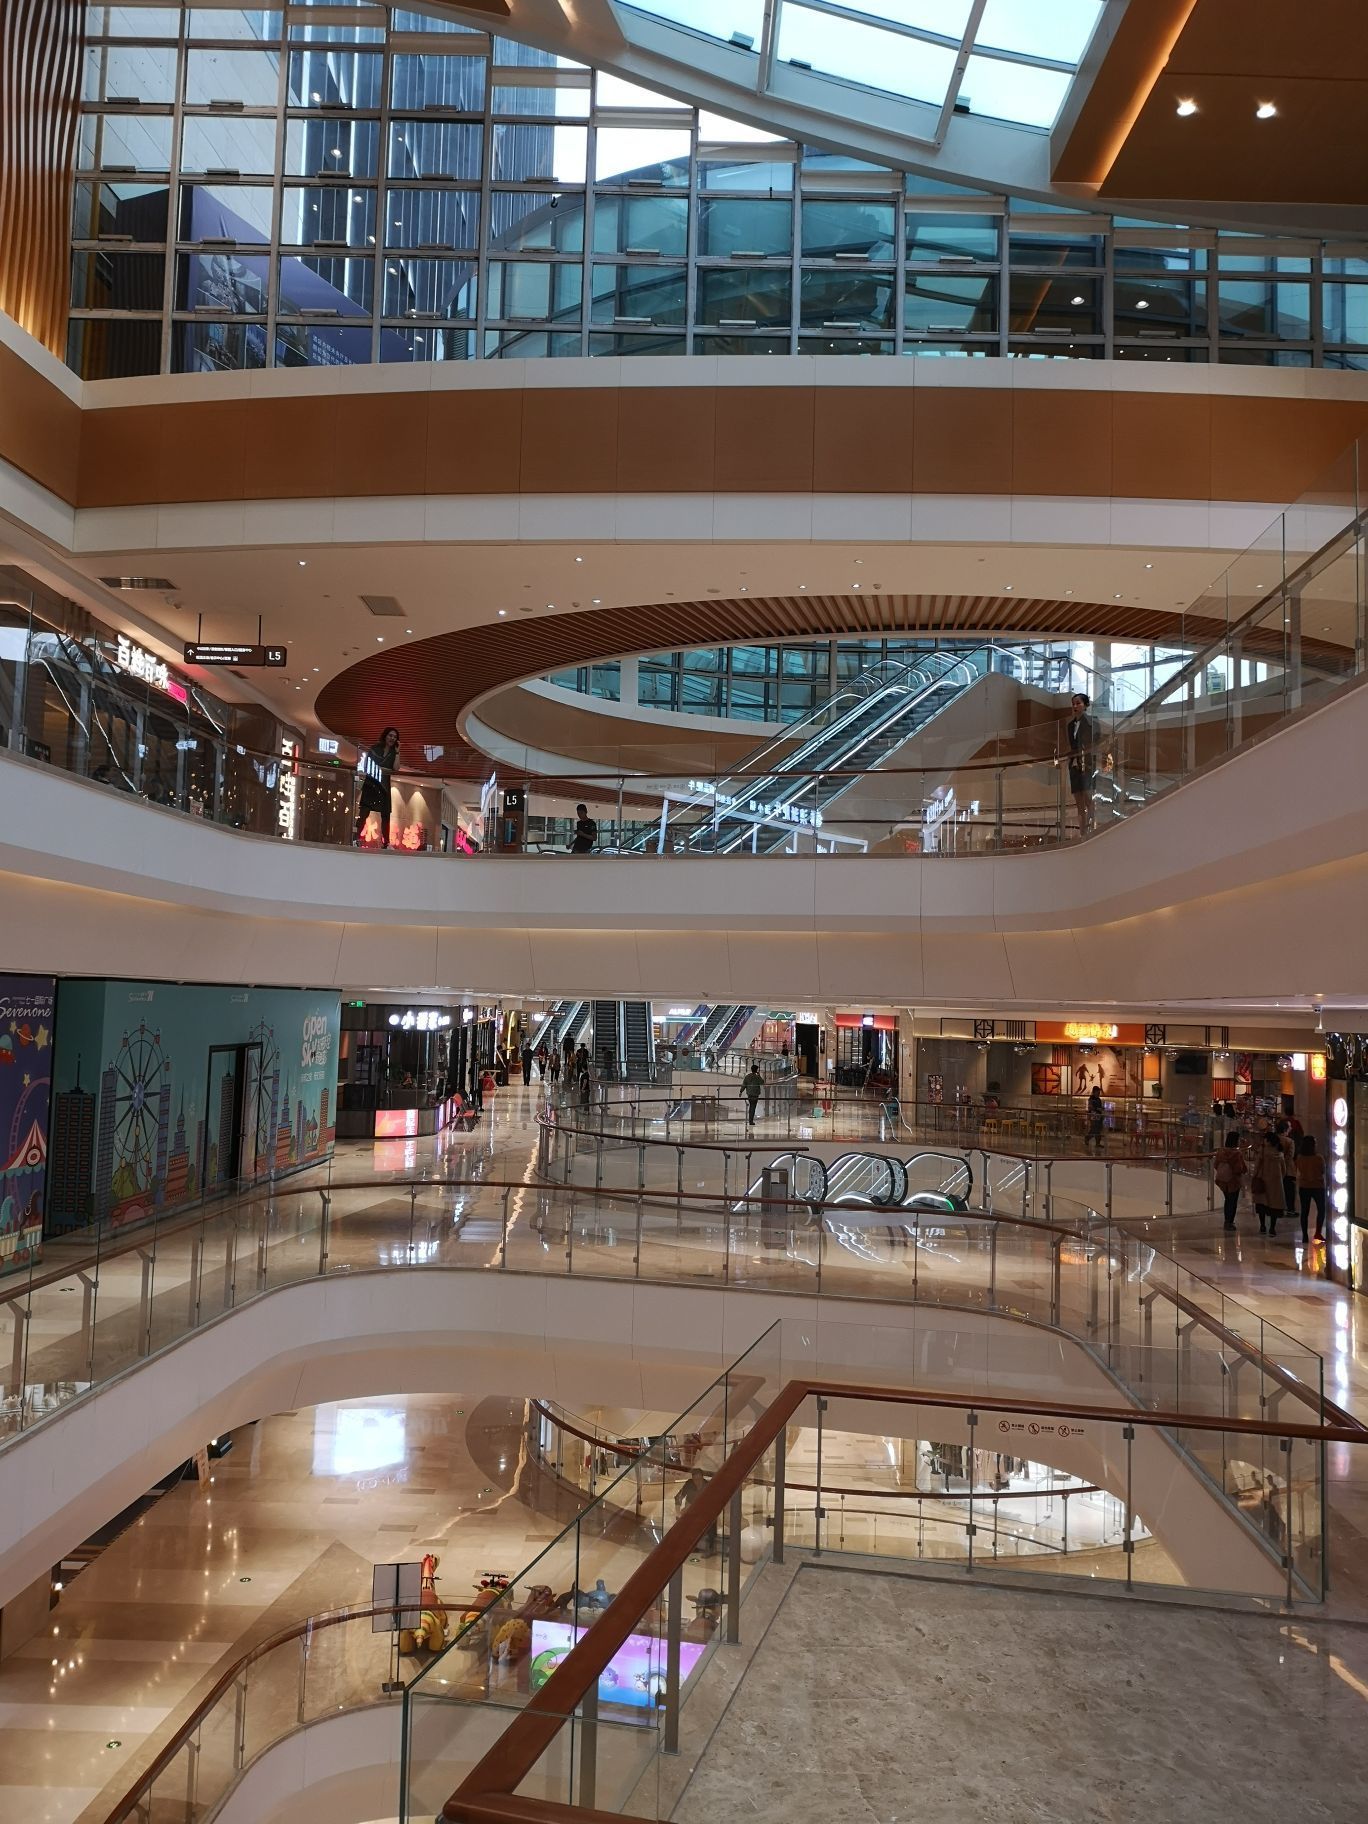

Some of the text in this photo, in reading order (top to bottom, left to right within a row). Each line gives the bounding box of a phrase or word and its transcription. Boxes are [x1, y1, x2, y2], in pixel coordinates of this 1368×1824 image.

[268, 651, 281, 661] L5
[506, 795, 517, 806] L5
[303, 1015, 328, 1042] Open
